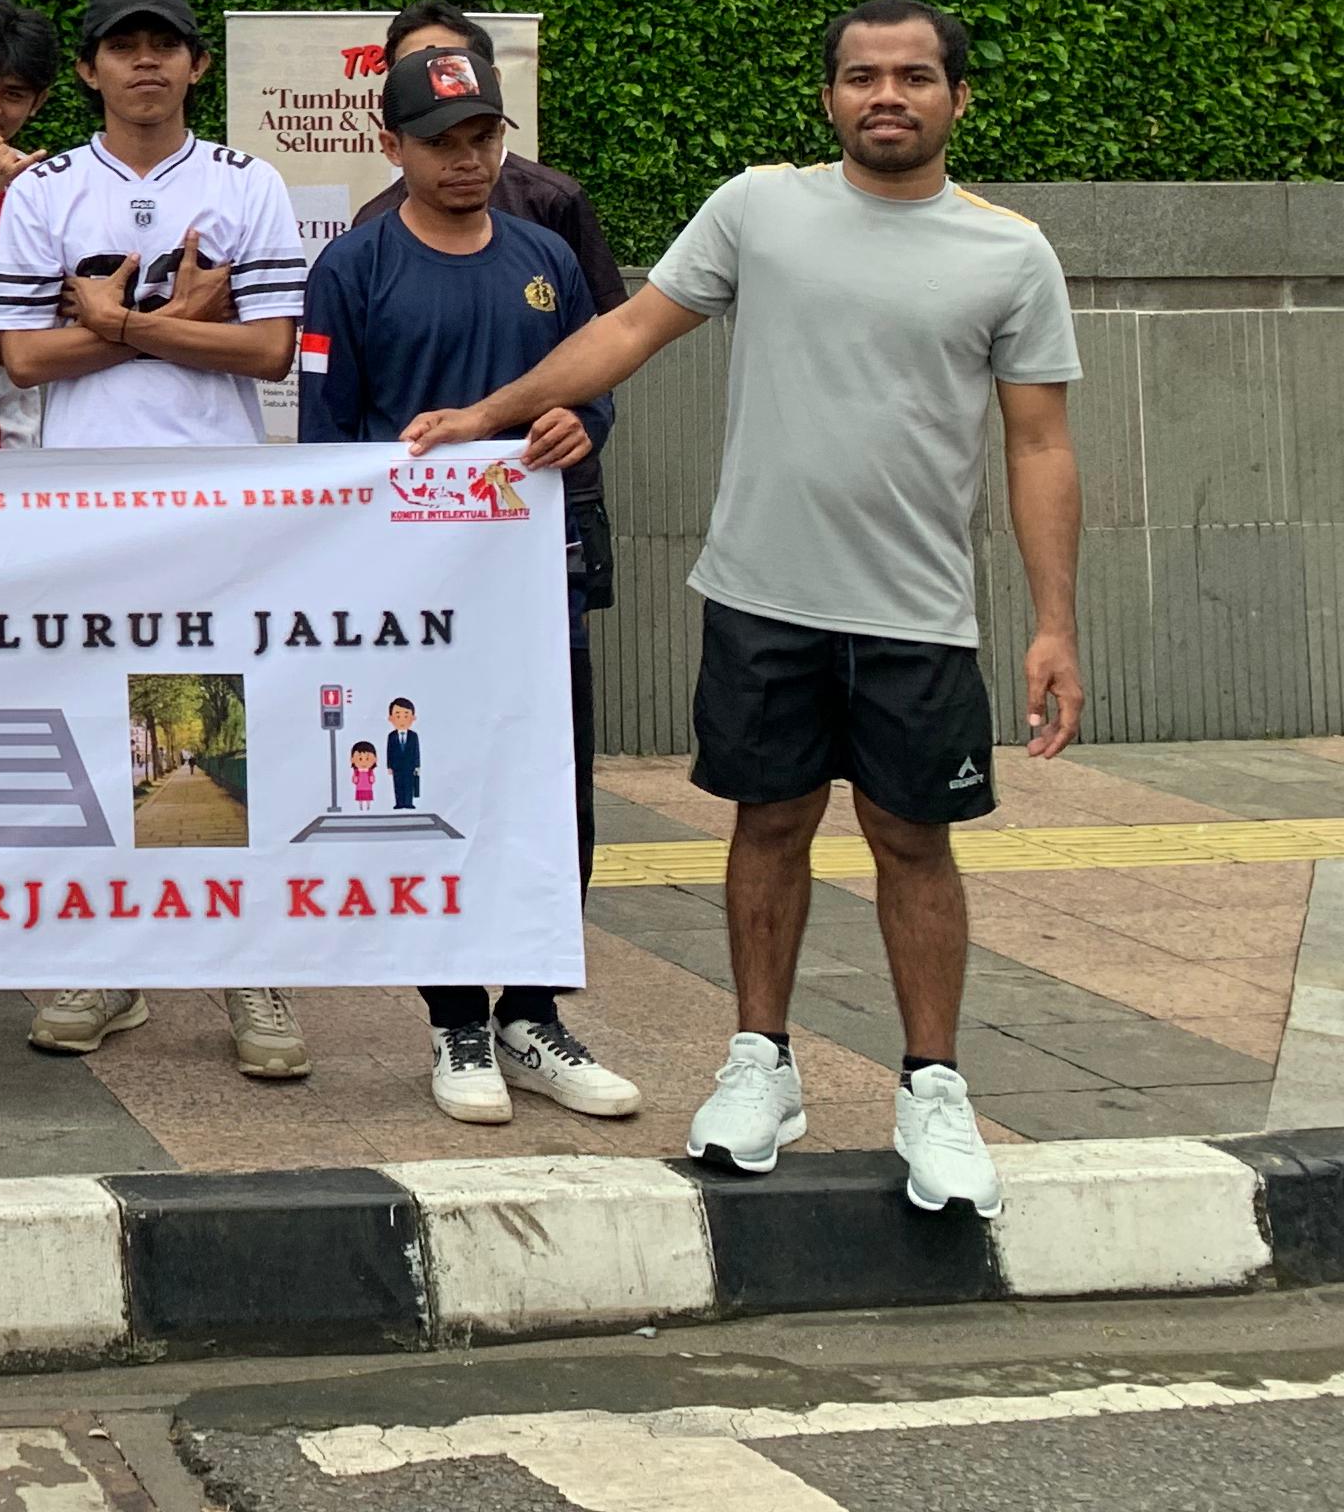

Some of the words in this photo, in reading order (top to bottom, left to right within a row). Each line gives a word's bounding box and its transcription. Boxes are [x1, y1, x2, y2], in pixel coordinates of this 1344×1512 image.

[341, 44, 390, 79] TR
[258, 110, 333, 131] Aman
[339, 110, 359, 131] &
[276, 131, 374, 153] Seluruh
[389, 467, 477, 481] KIBAR
[21, 490, 228, 510] INTELEKTUAL
[243, 487, 375, 508] BERSATU
[390, 510, 425, 520] KOMITE
[427, 509, 489, 520] INTELEKTUAL
[253, 608, 457, 657] JALAN
[286, 874, 463, 919] KAKI
